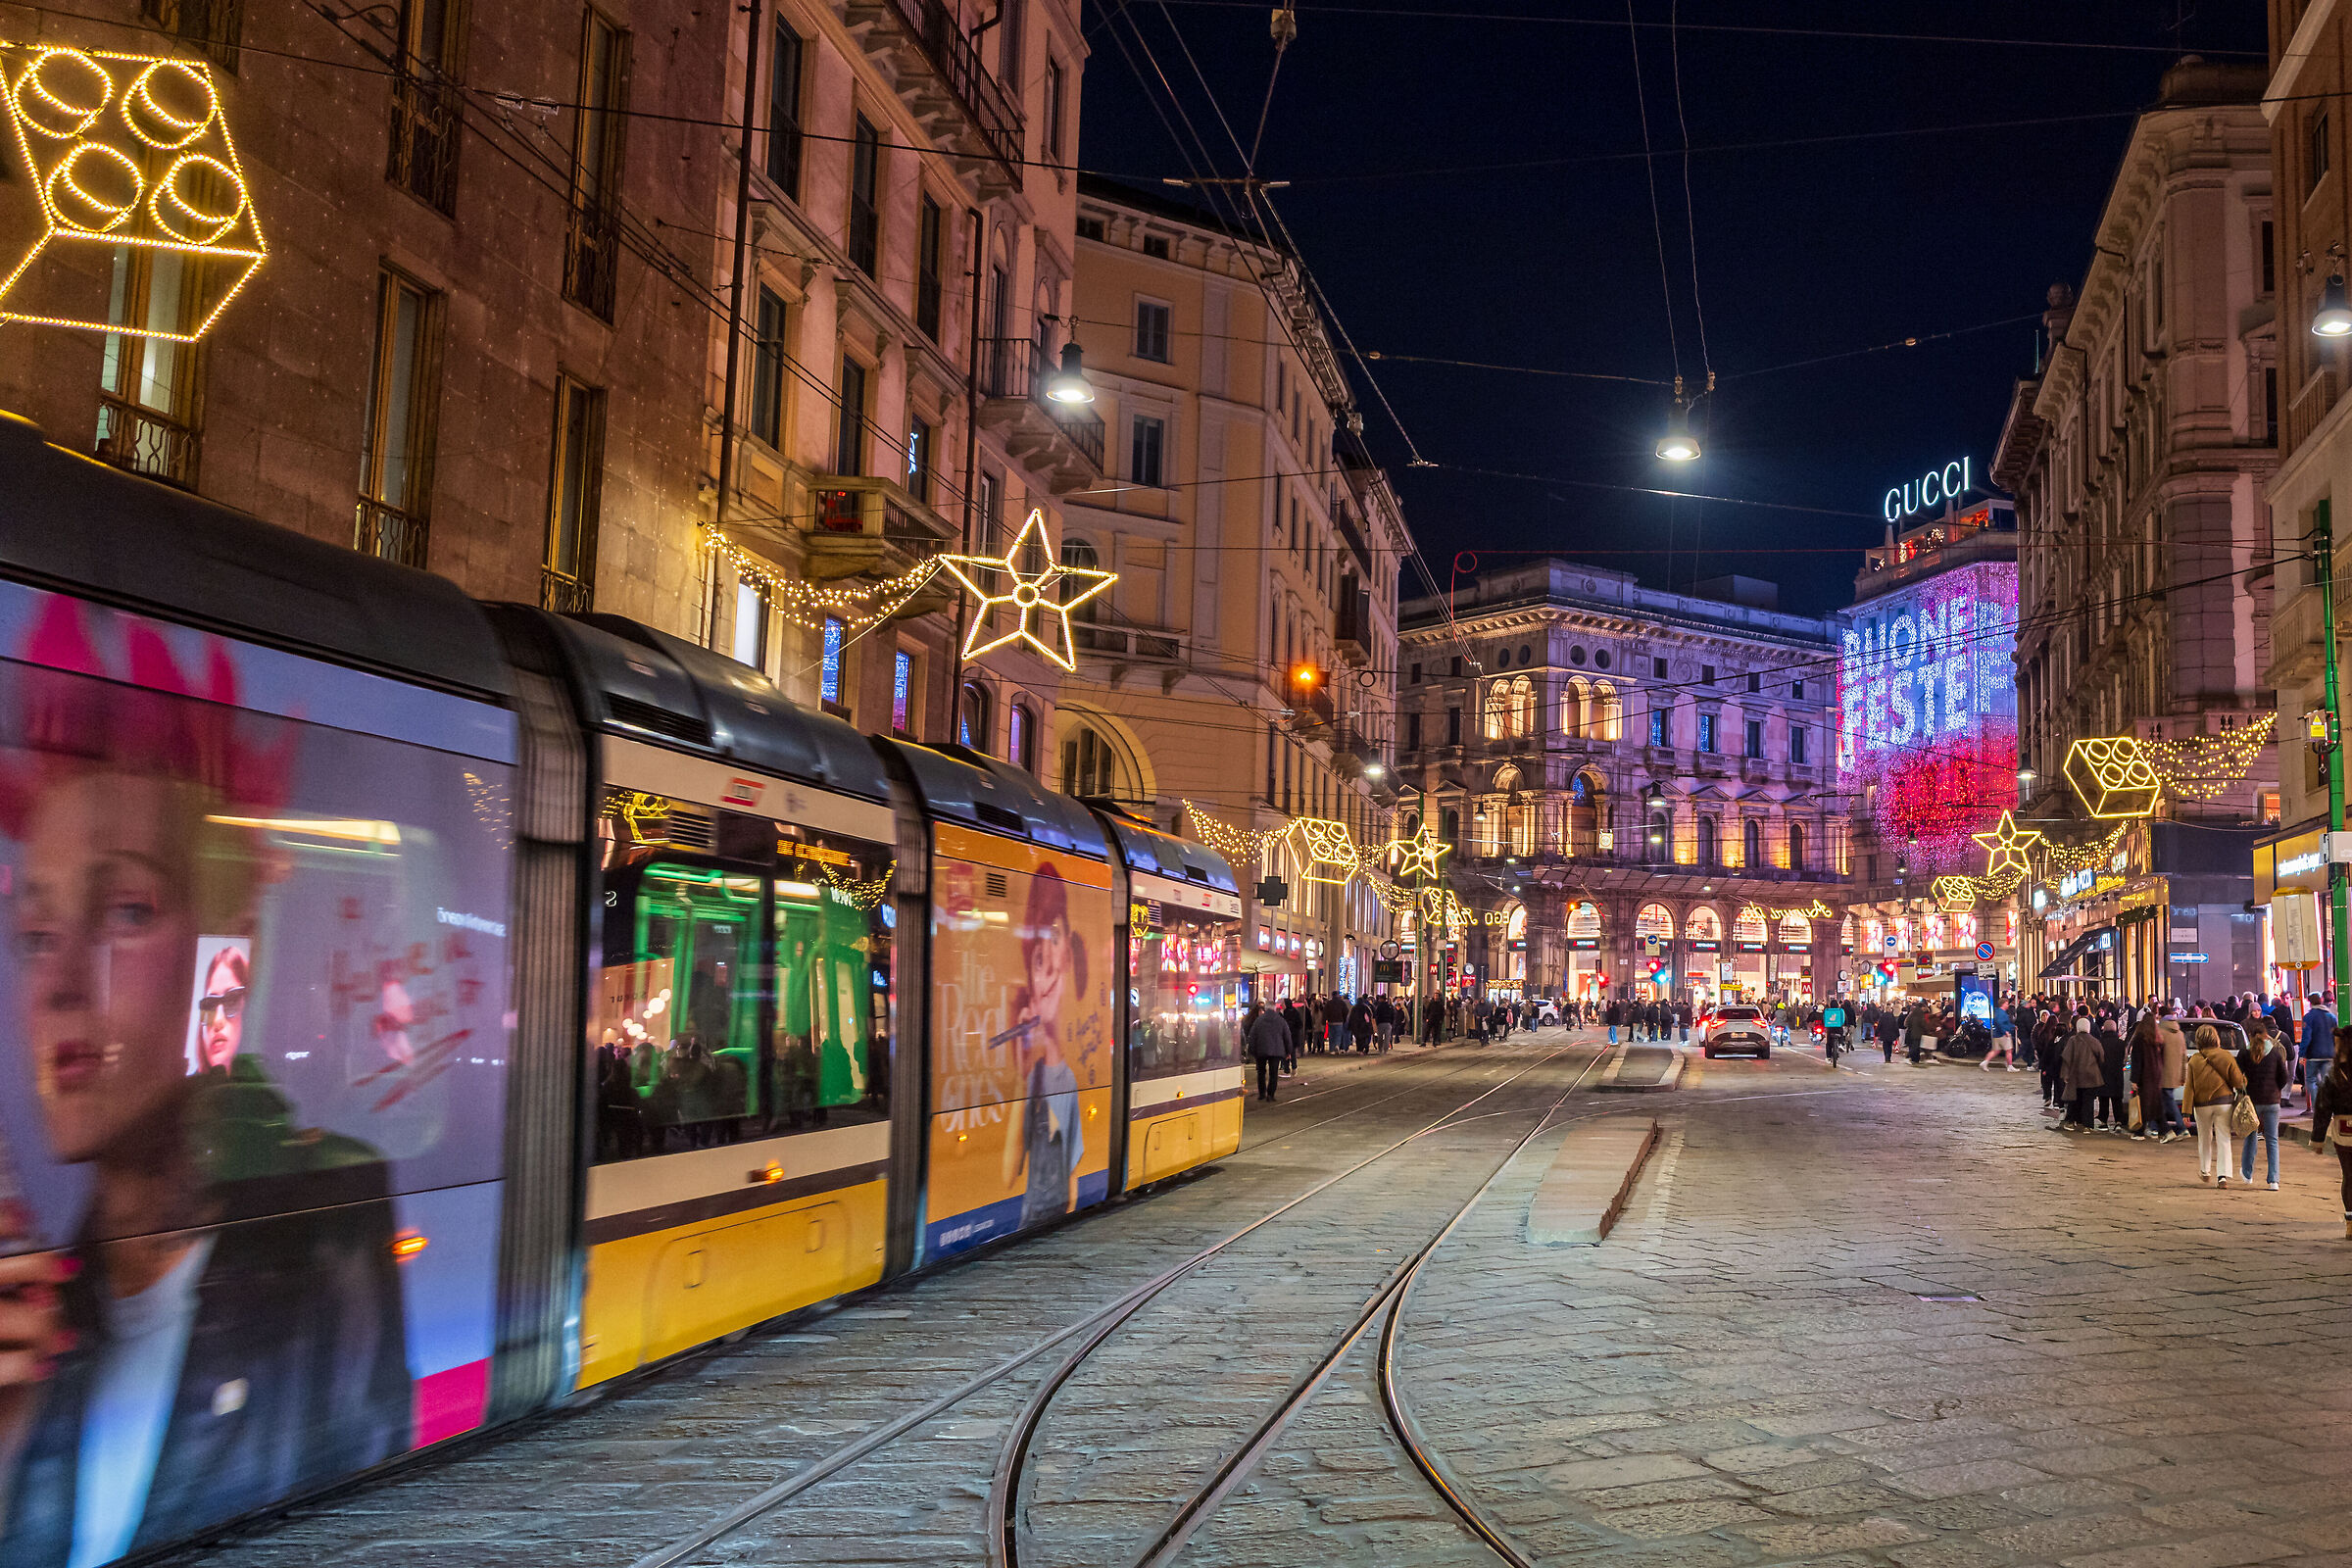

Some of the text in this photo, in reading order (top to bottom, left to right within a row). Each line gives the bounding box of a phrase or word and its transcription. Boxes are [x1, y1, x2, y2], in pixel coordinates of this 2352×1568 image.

[1884, 456, 1970, 522] GUCCI
[1841, 594, 1967, 684] BUONE
[1841, 654, 1968, 773] FESTE
[938, 982, 1007, 1074] Red
